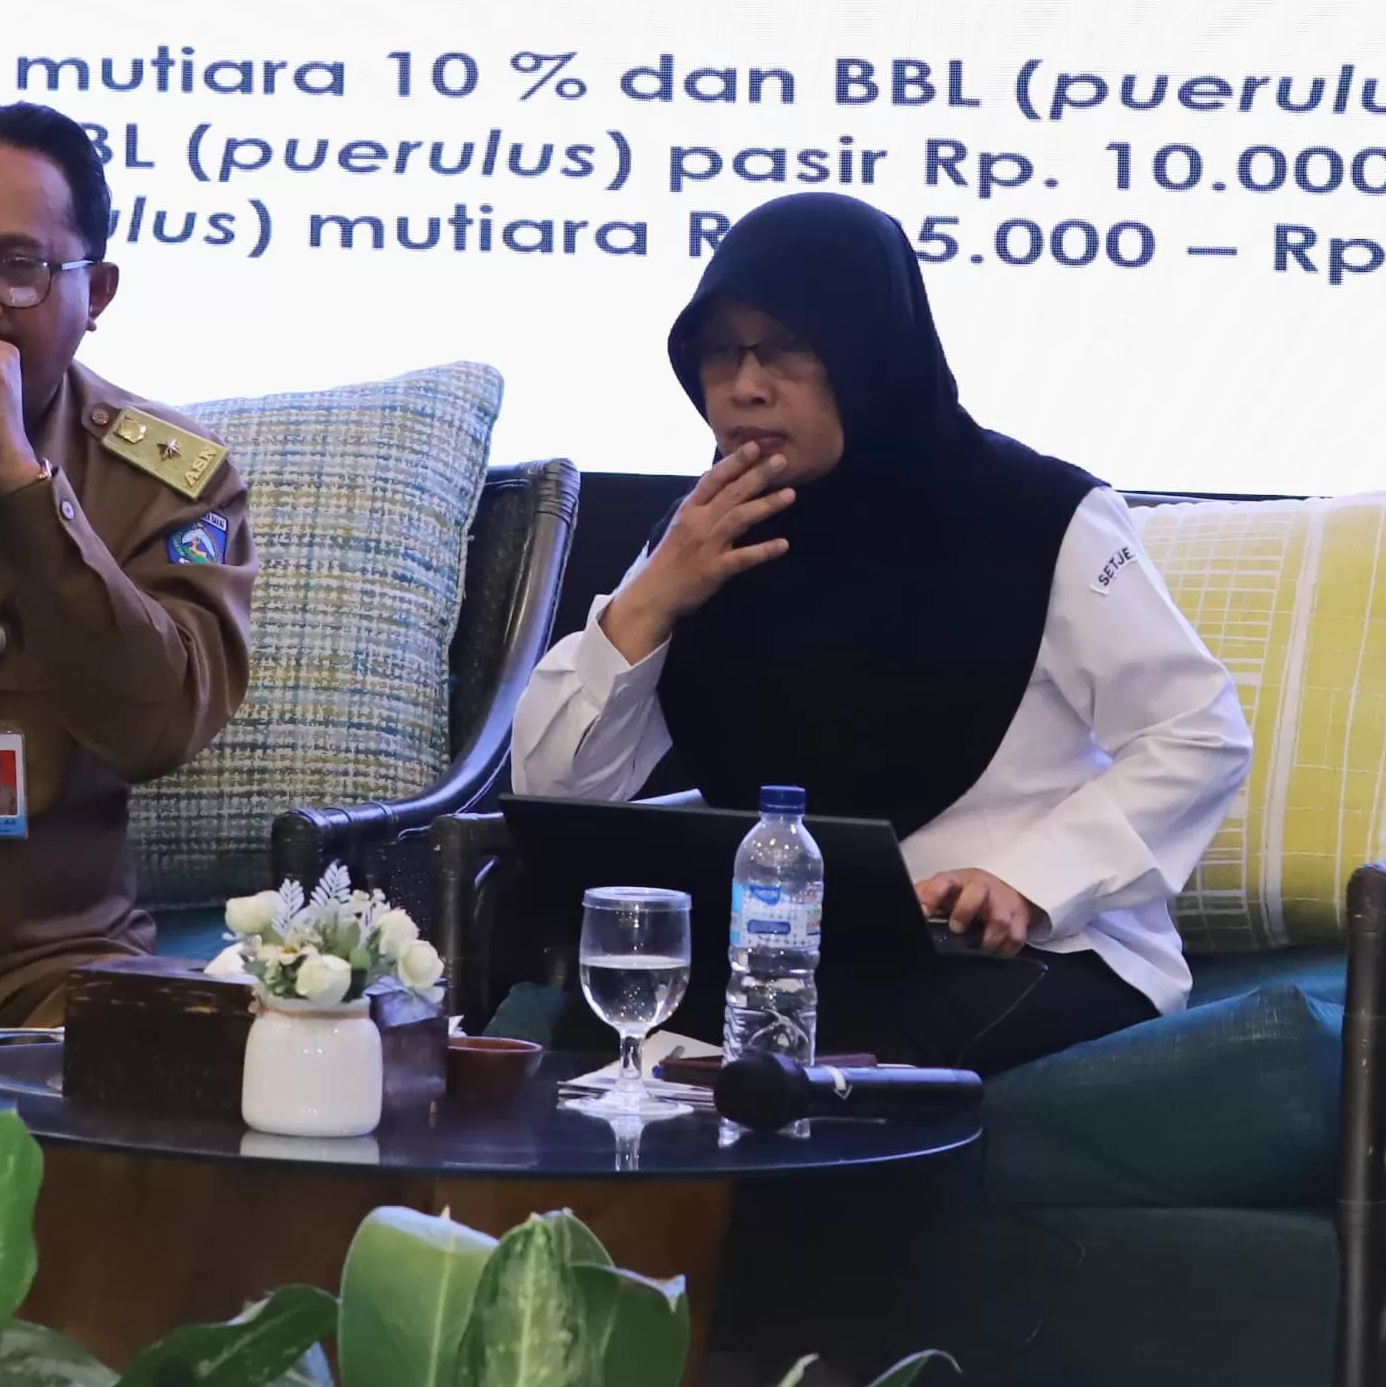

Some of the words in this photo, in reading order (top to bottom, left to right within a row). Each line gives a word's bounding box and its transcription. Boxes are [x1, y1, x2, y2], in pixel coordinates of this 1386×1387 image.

[16, 46, 344, 97] mutiara
[387, 52, 478, 98] 10
[511, 52, 587, 100] %
[620, 54, 794, 104] dan
[836, 59, 980, 107] BBL
[187, 124, 631, 190] (puerulus)
[670, 136, 887, 191] pasir
[925, 138, 1058, 199] Rp.
[310, 204, 647, 255] mutiara
[917, 216, 1156, 268] 5.000
[184, 447, 217, 488] ASN
[1098, 547, 1134, 587] SETJE
